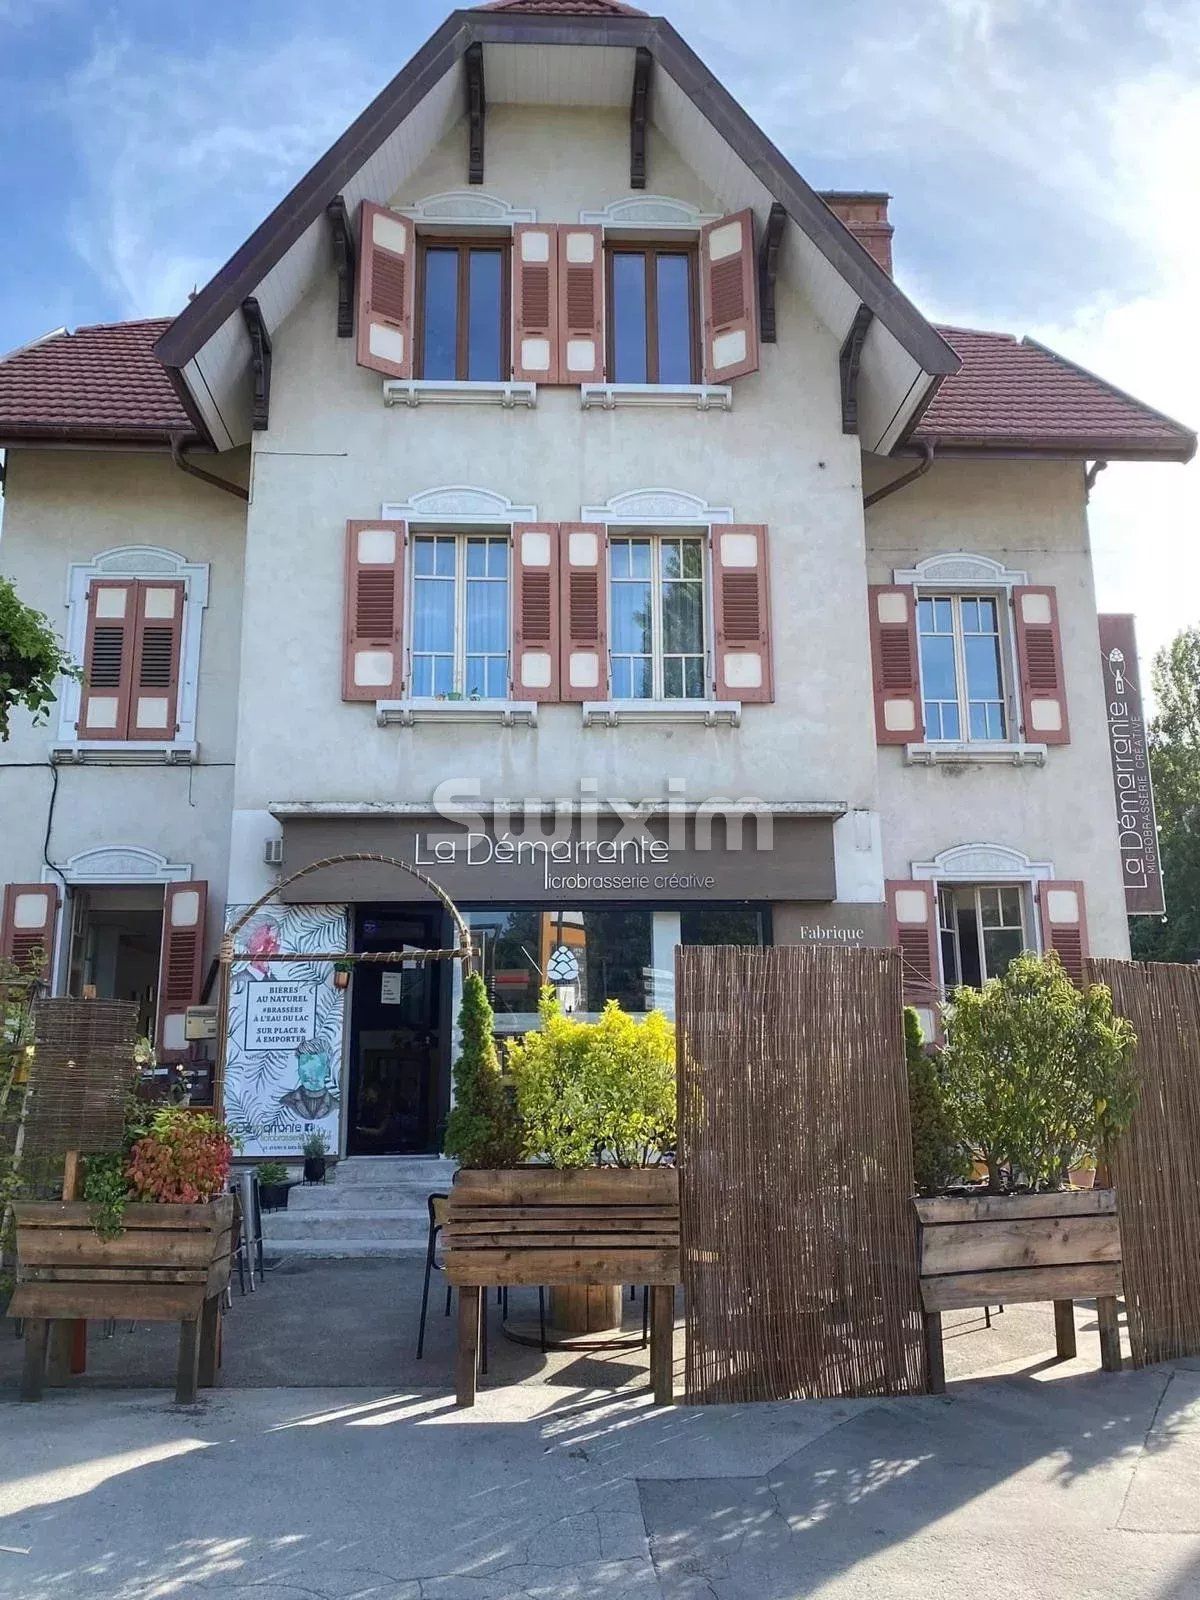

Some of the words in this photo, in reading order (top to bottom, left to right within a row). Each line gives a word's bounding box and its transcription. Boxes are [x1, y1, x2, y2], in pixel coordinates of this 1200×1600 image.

[1131, 716, 1145, 769] CRÉATIVE
[1106, 701, 1143, 850] Démarrante
[1138, 775, 1156, 874] MICROBRASSERIE
[415, 833, 456, 865] La
[467, 832, 669, 883] Démarrante
[1123, 858, 1147, 889] La
[654, 873, 715, 889] créative
[800, 925, 864, 941] Fabrique
[270, 995, 308, 1003] NATUREL
